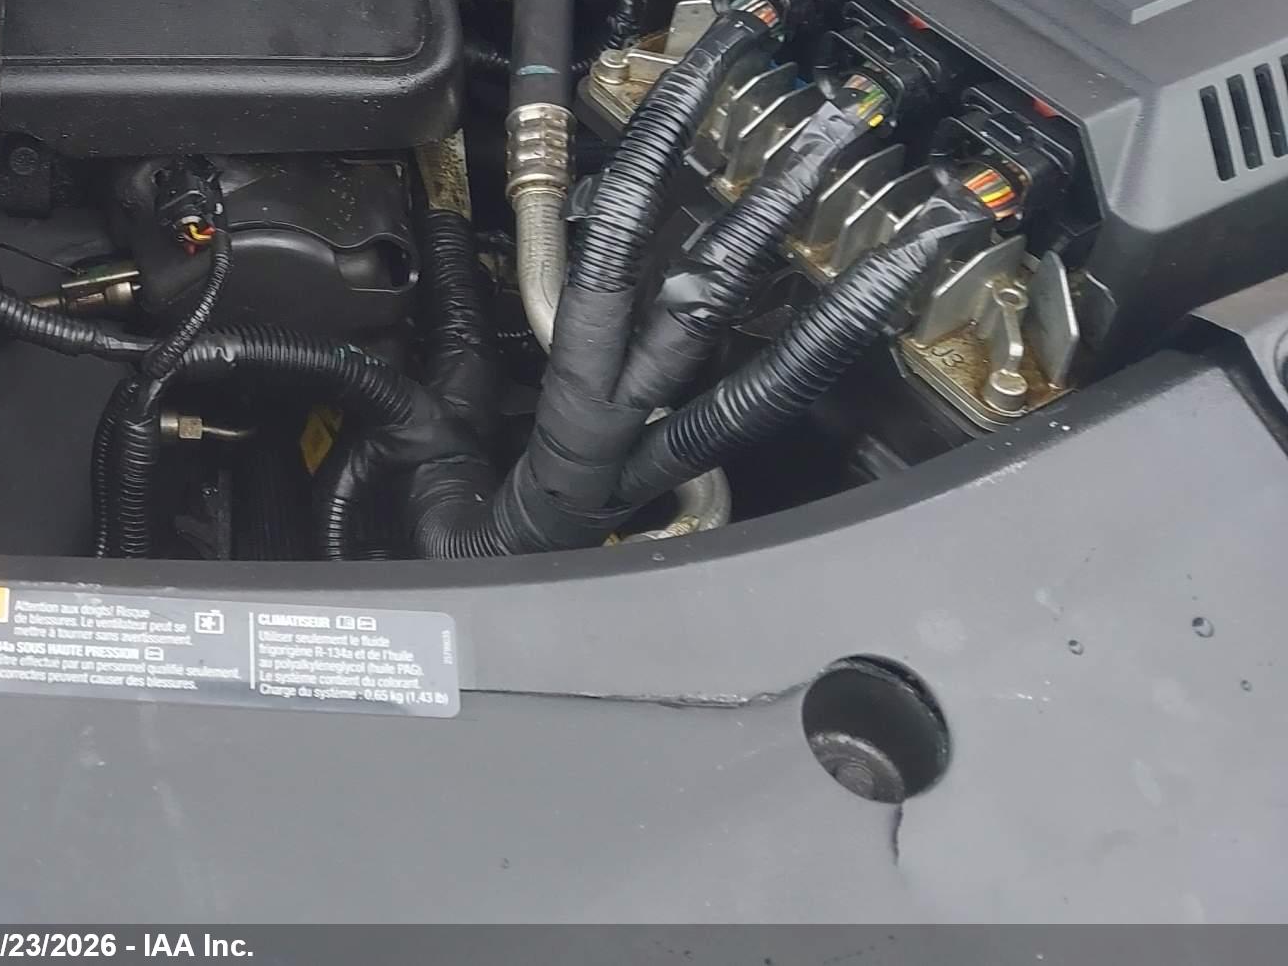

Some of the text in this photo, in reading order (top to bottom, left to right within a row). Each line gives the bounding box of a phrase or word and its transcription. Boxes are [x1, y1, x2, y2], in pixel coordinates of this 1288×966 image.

[14, 600, 59, 613] Attention
[60, 604, 79, 615] aux
[116, 605, 151, 619] Risque
[14, 613, 27, 624] de
[80, 616, 94, 628] Le
[95, 618, 148, 631] ventilateur
[149, 620, 172, 633] peut
[173, 622, 187, 633] se
[257, 614, 331, 629] CLIMATISEUR
[14, 626, 47, 638] mettre
[57, 628, 93, 640] tourner
[94, 631, 119, 641] sans
[294, 632, 348, 645] seulement
[349, 634, 360, 646] le
[360, 635, 390, 648] fluide
[16, 641, 46, 654] SOUS
[47, 643, 83, 657] HAUTE
[84, 645, 139, 660] PRESSION
[314, 645, 353, 659] R-134a
[354, 648, 366, 660] et
[367, 649, 382, 660] de
[80, 660, 94, 670] un
[95, 660, 146, 673] personnel
[259, 658, 273, 669] au
[47, 671, 89, 684] peuvent
[89, 675, 124, 686] causer
[125, 675, 145, 687] des
[259, 670, 273, 682] Le
[319, 673, 361, 686] contient
[361, 675, 376, 688] du
[259, 683, 297, 698] Charge
[298, 685, 312, 697] du
[390, 690, 404, 704] kg
[434, 692, 449, 706] lb)
